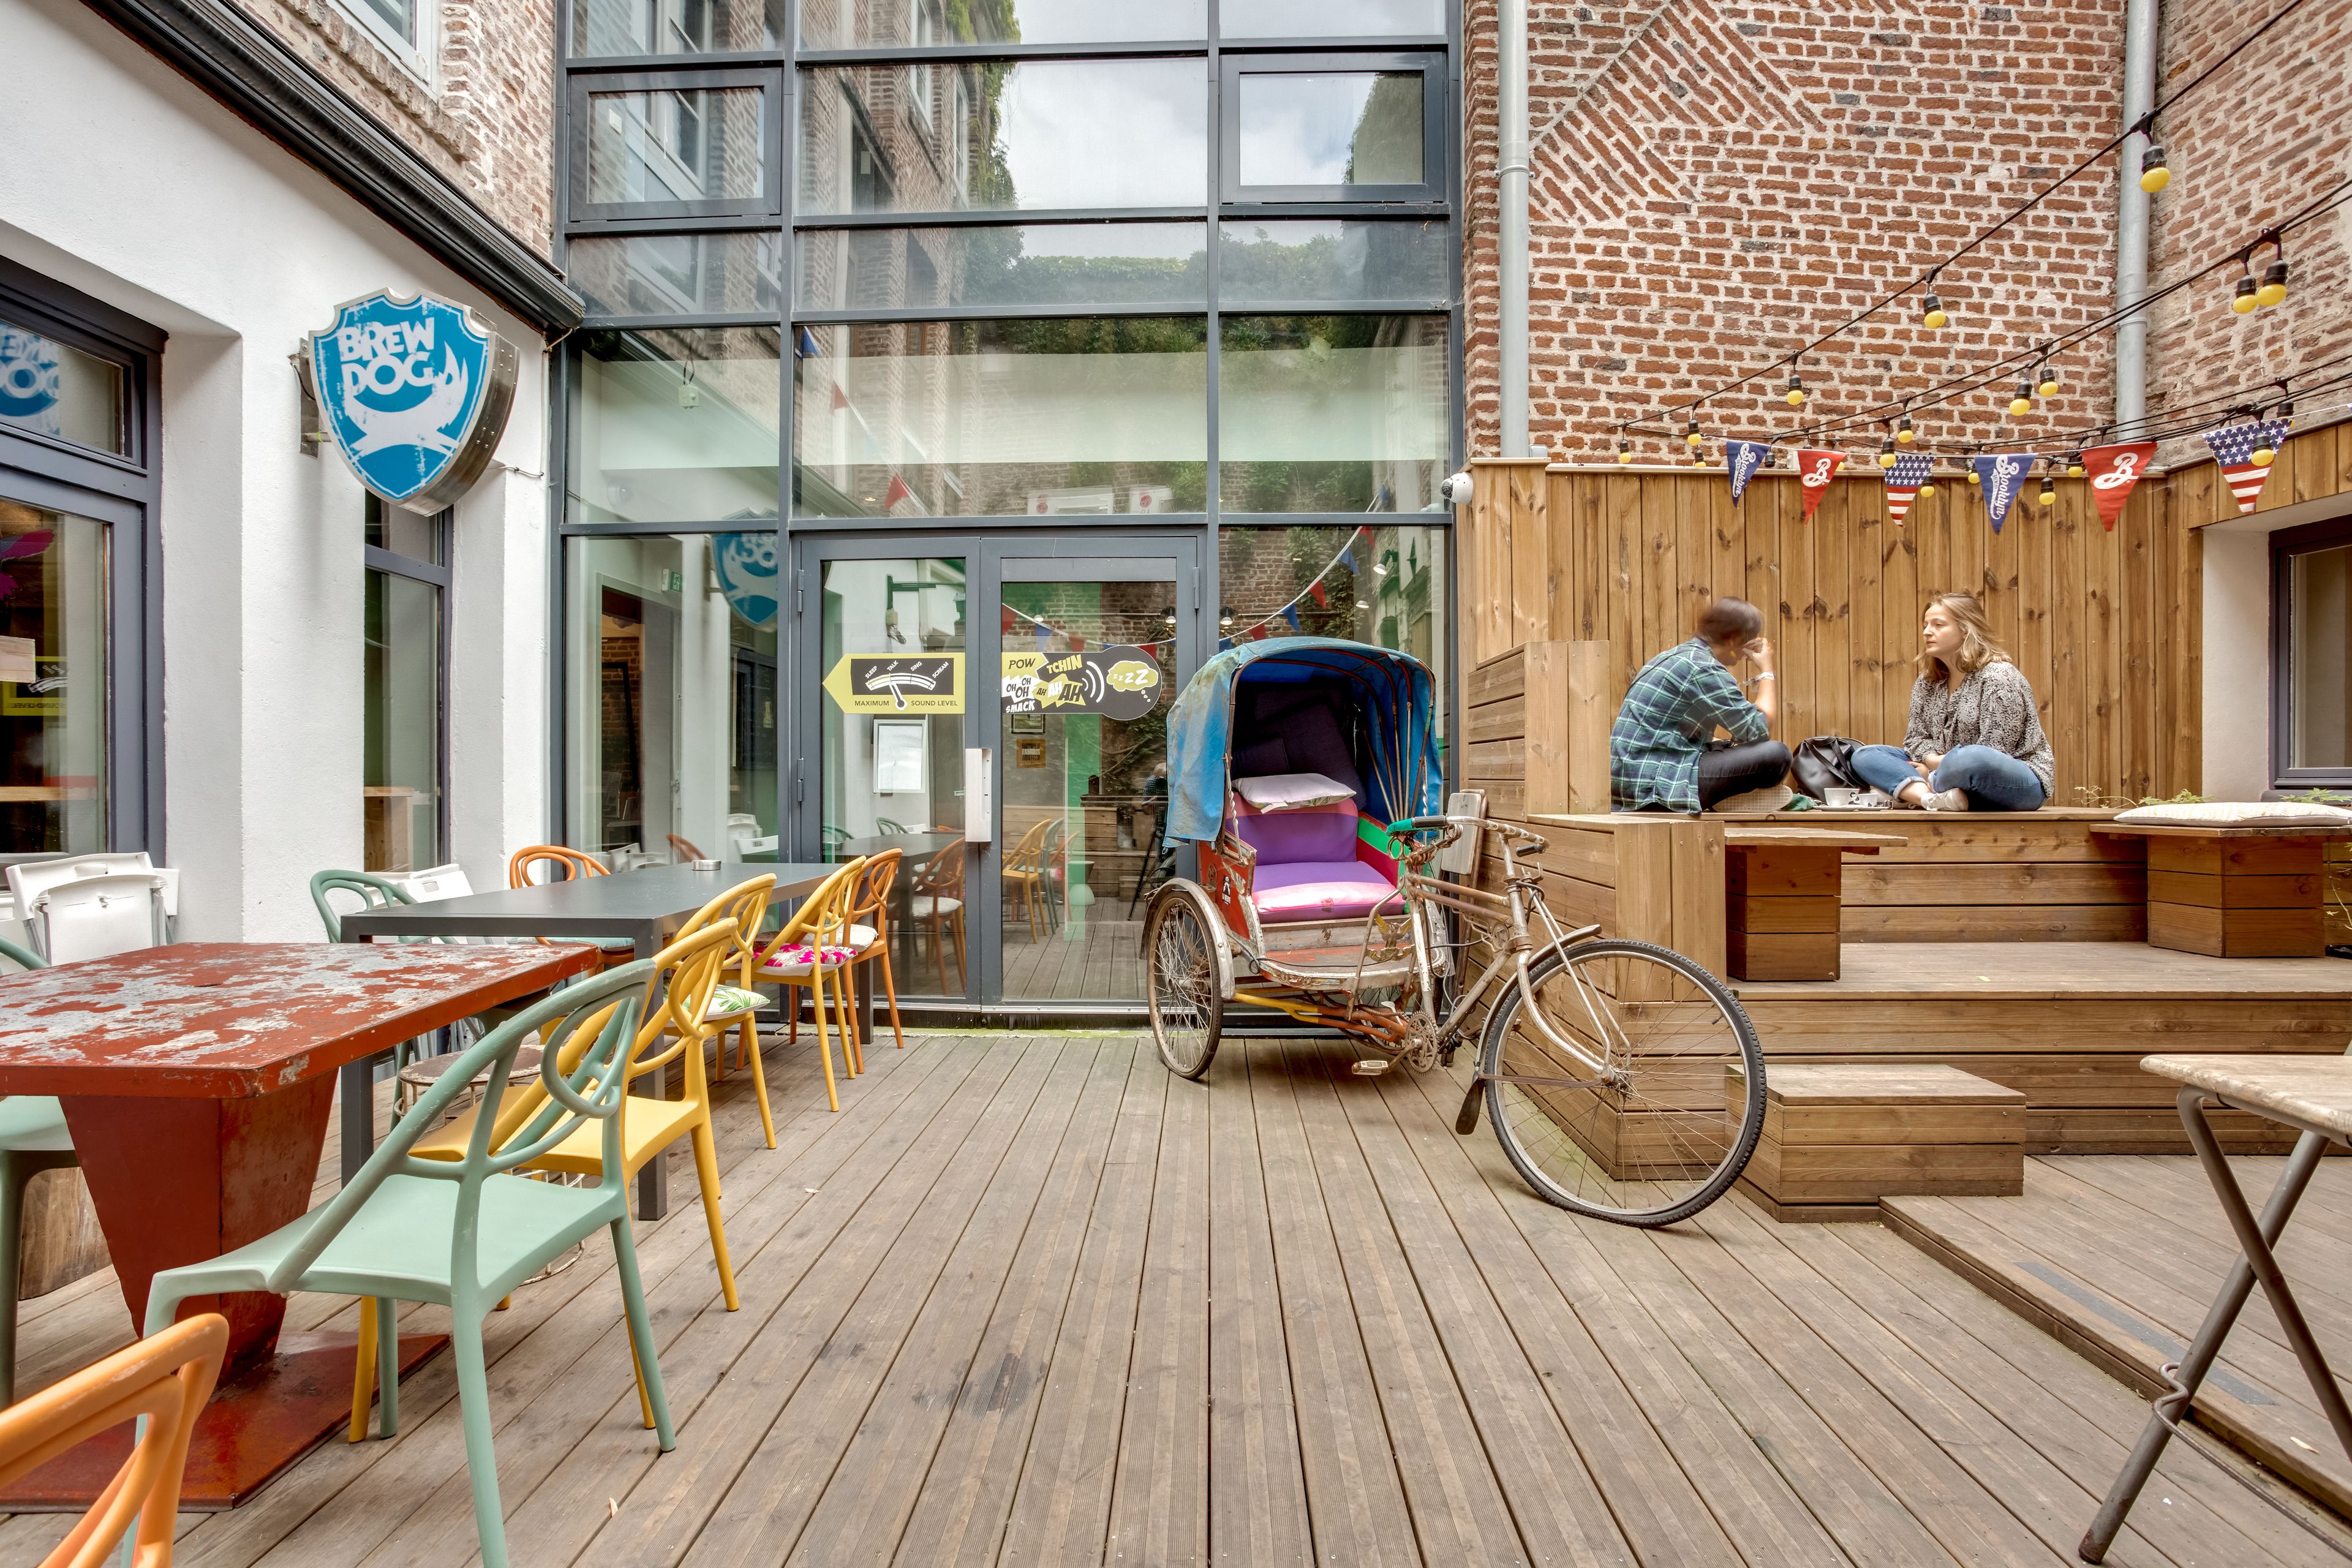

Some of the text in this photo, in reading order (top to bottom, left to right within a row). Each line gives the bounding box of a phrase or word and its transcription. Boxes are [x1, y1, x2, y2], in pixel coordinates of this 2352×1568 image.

[336, 317, 435, 362] BREW
[341, 351, 434, 397] DOG
[1735, 443, 1757, 496] Brooklyn
[1994, 454, 2019, 516] Brooklyn
[886, 660, 899, 672] TALK
[910, 661, 922, 672] SING
[932, 661, 949, 679] SCREAM
[1008, 658, 1036, 670] POW
[1046, 654, 1083, 674] TCHIN
[865, 665, 878, 679] SLEEP
[1006, 684, 1017, 693] OH
[1021, 677, 1031, 686] OH
[1015, 686, 1030, 698] OH
[1036, 680, 1084, 702] AH AH AH
[1005, 699, 1036, 714] SMACK
